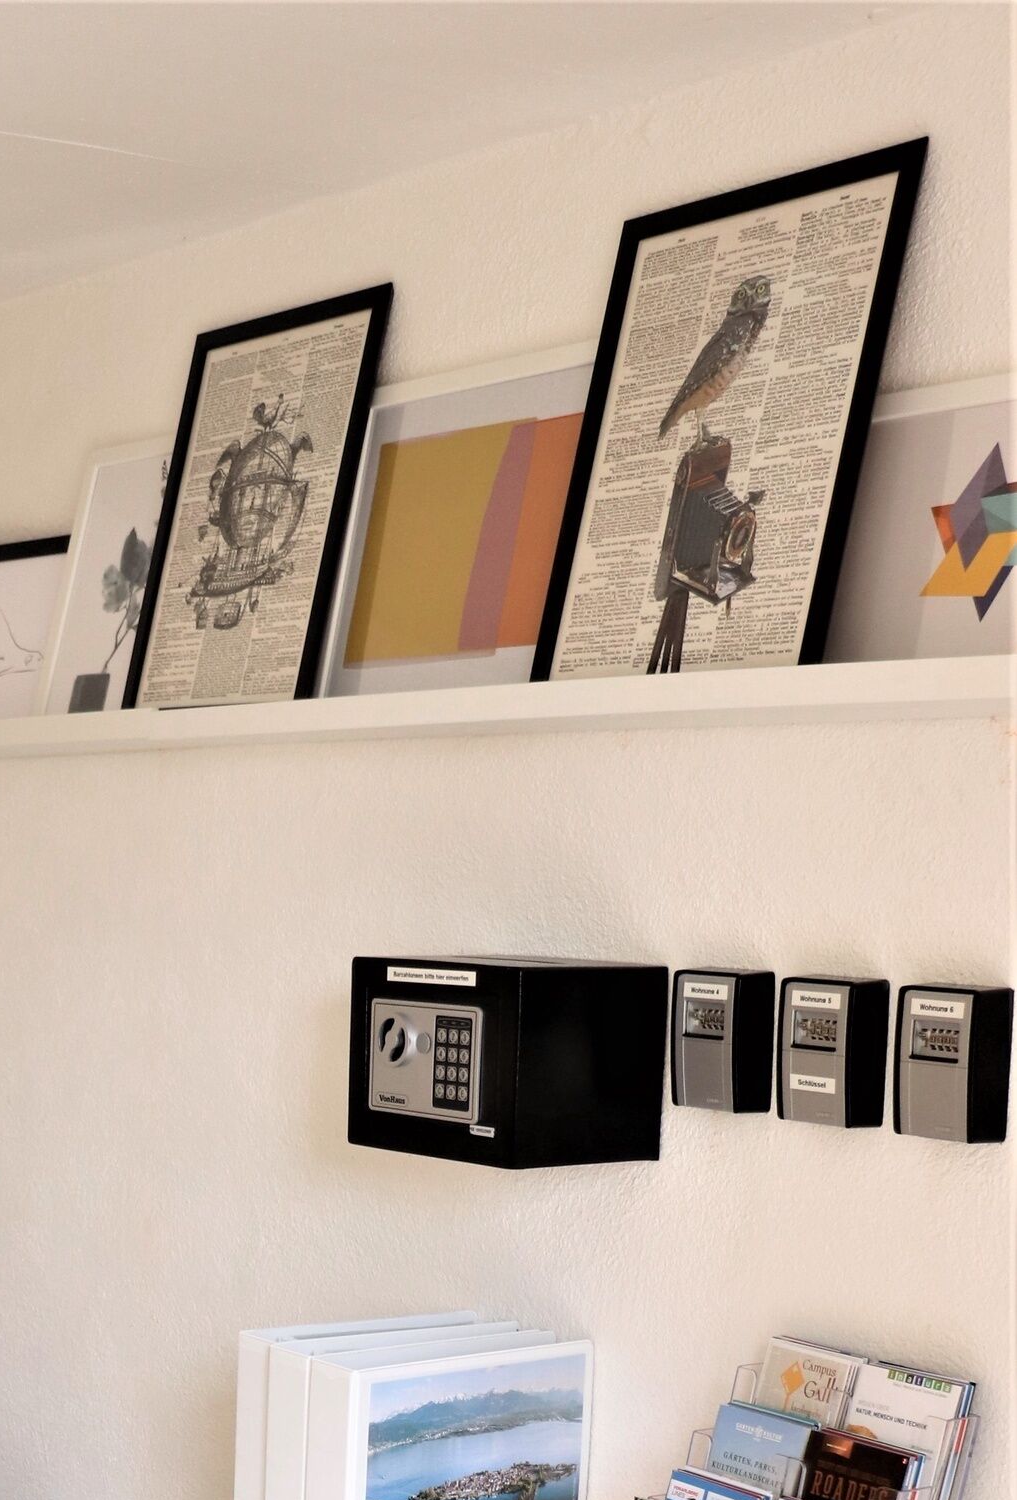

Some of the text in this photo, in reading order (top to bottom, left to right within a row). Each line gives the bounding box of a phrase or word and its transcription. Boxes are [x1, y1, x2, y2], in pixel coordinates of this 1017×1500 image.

[800, 995, 826, 1004] Wohnung
[919, 1003, 948, 1013] Wohnung
[797, 1079, 827, 1089] Schlüssel
[379, 1094, 406, 1105] VonHaus
[802, 1359, 837, 1379] Campus
